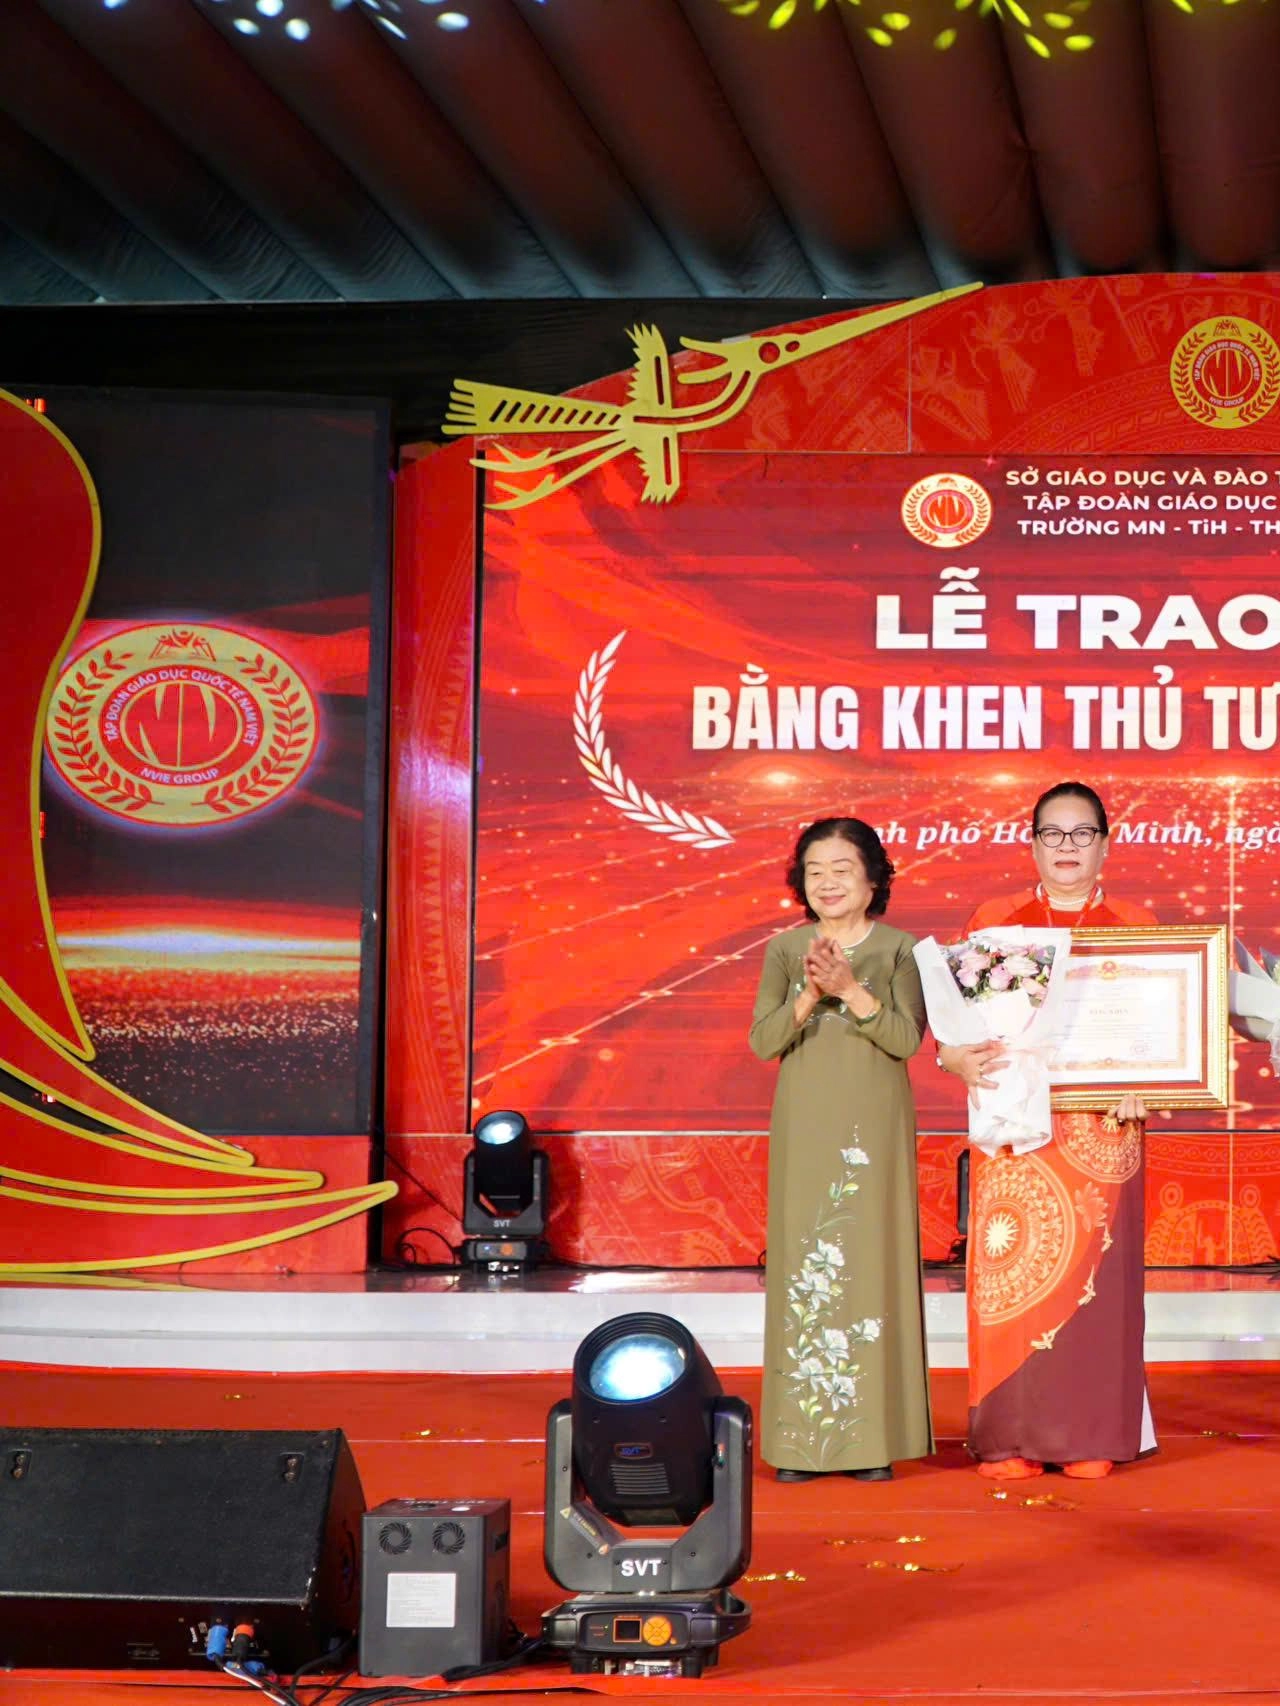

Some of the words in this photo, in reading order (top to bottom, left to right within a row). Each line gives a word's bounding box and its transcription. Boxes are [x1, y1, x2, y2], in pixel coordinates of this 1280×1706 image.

[1006, 466, 1038, 485] SỞ
[1046, 468, 1106, 485] GIÁO
[1114, 471, 1165, 488] DỤC
[1173, 468, 1206, 485] VÀ
[1213, 468, 1268, 485] ĐÀO
[1023, 492, 1070, 513] TẬP
[1078, 493, 1149, 510] ĐOÀN
[1157, 493, 1217, 510] GIÁO
[1226, 496, 1277, 512] DỤC
[1017, 517, 1120, 534] TRƯỜNG
[1127, 520, 1165, 534] MN
[876, 567, 987, 649] LỄ
[692, 663, 858, 750] BẰNG
[883, 685, 1042, 749] KHEN
[1064, 665, 1182, 750] THỦ
[173, 768, 220, 784] GROUP
[916, 820, 983, 850] phố
[1114, 821, 1213, 847] Minh,
[621, 1559, 662, 1577] SVT
